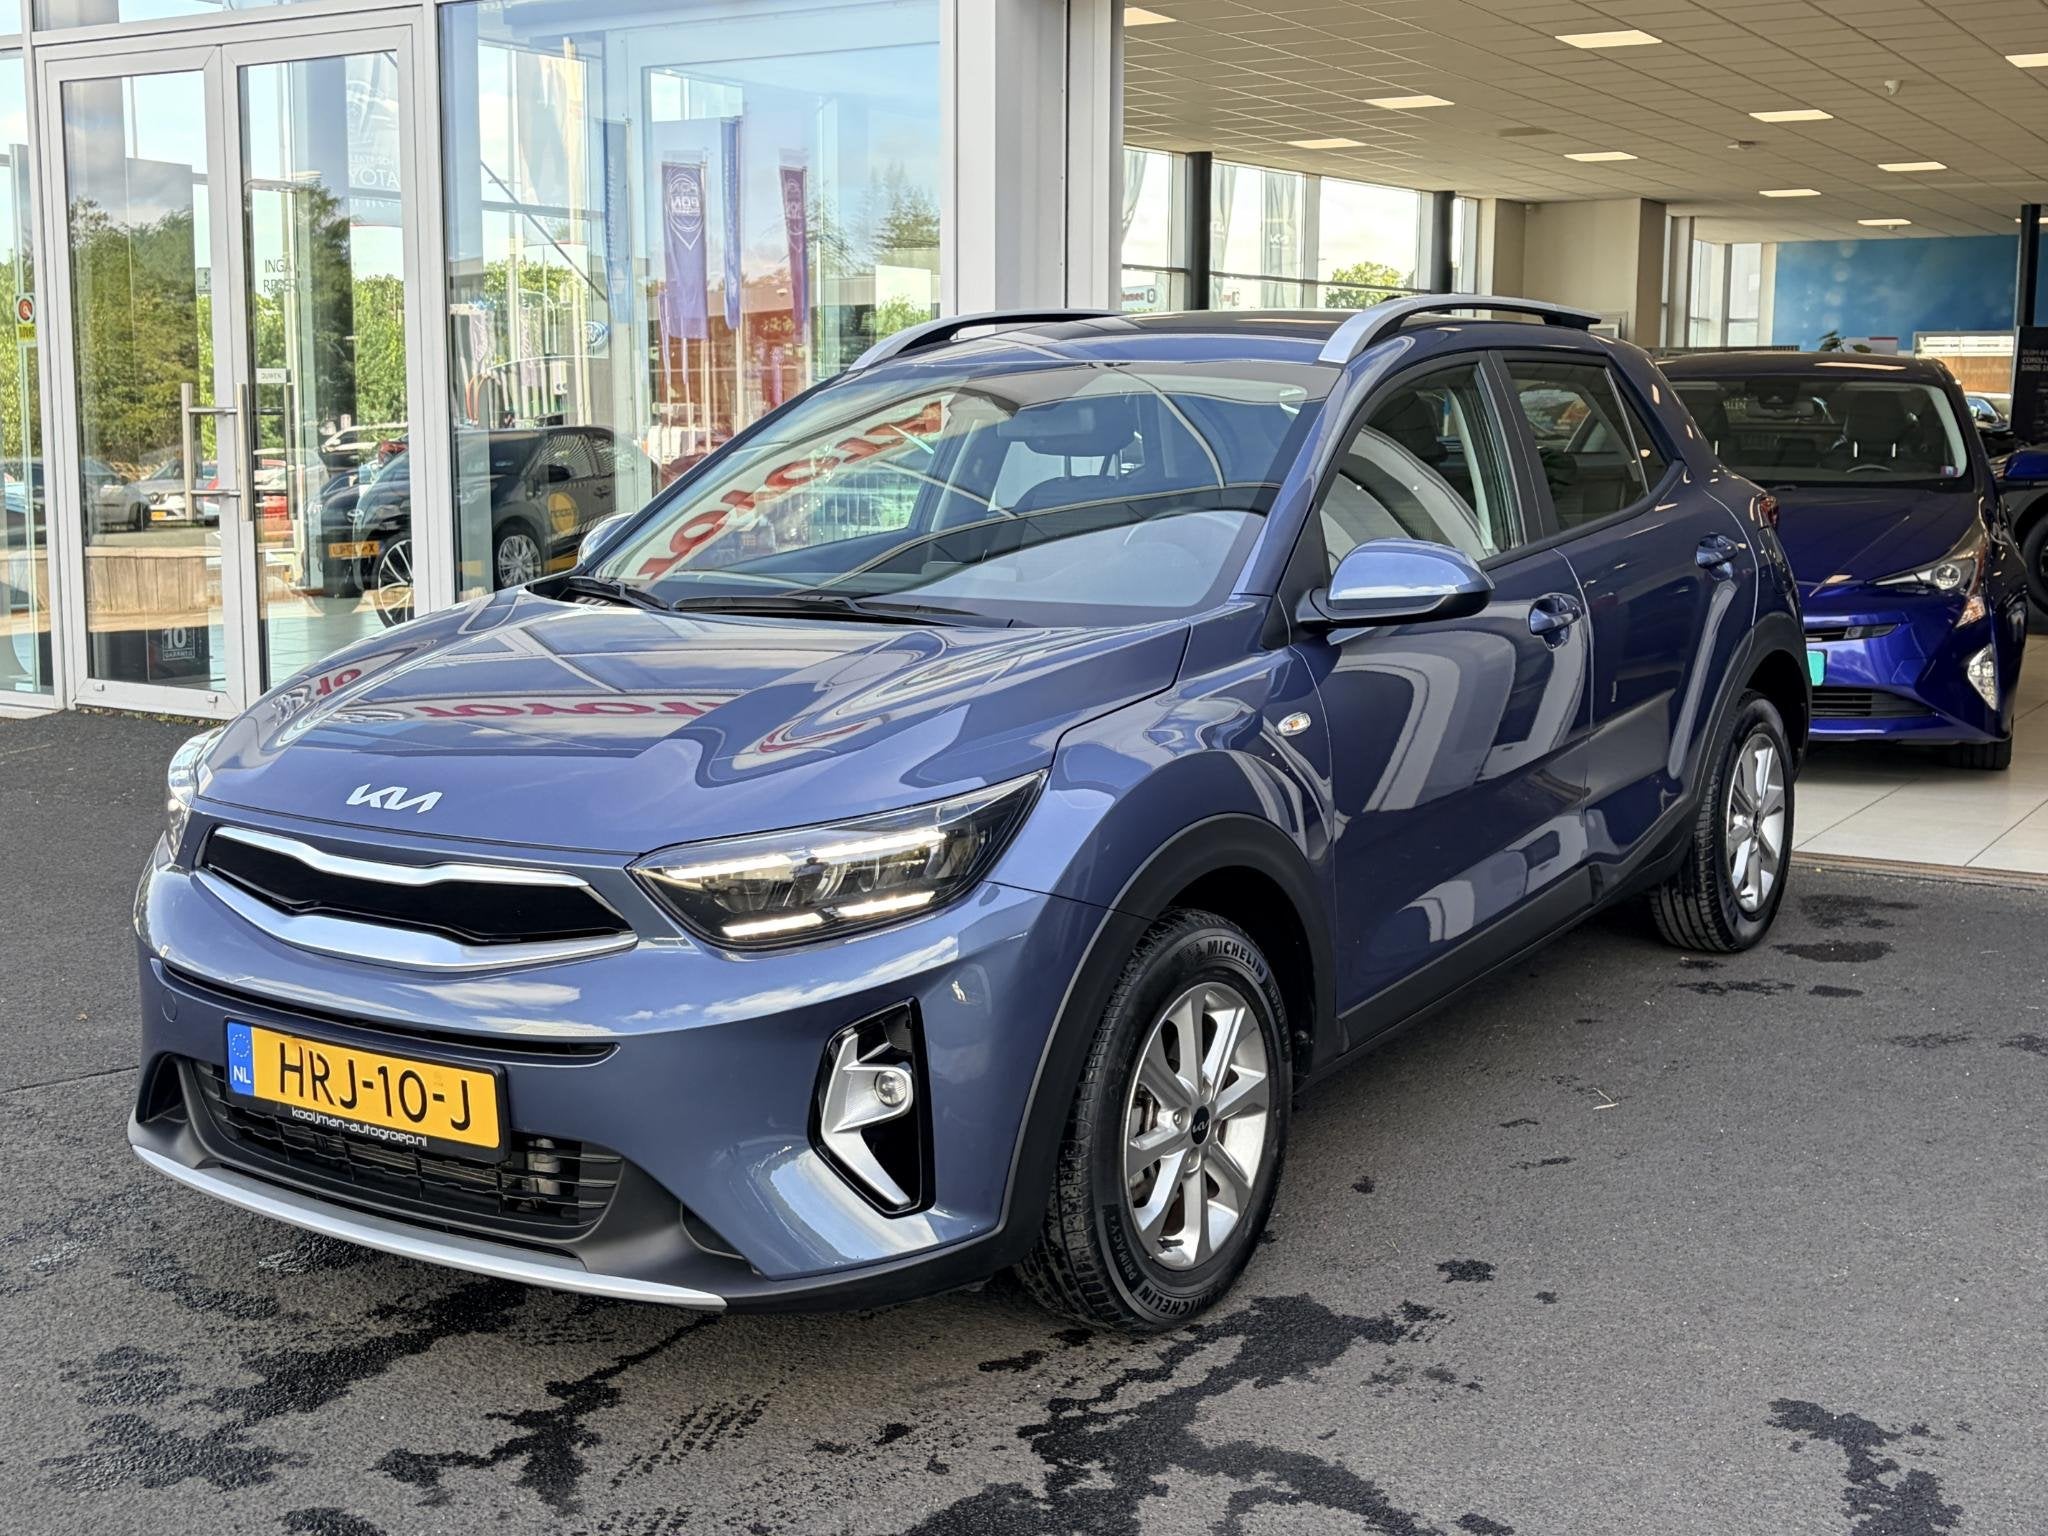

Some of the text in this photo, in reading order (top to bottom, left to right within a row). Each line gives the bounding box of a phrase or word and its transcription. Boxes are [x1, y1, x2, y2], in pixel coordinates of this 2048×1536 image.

[345, 783, 443, 814] KIA
[1207, 940, 1266, 978] MICHELIN
[233, 1065, 251, 1084] NL
[279, 1042, 471, 1131] HRJ-10-J
[291, 1106, 428, 1148] kooijman-autogroep.nl
